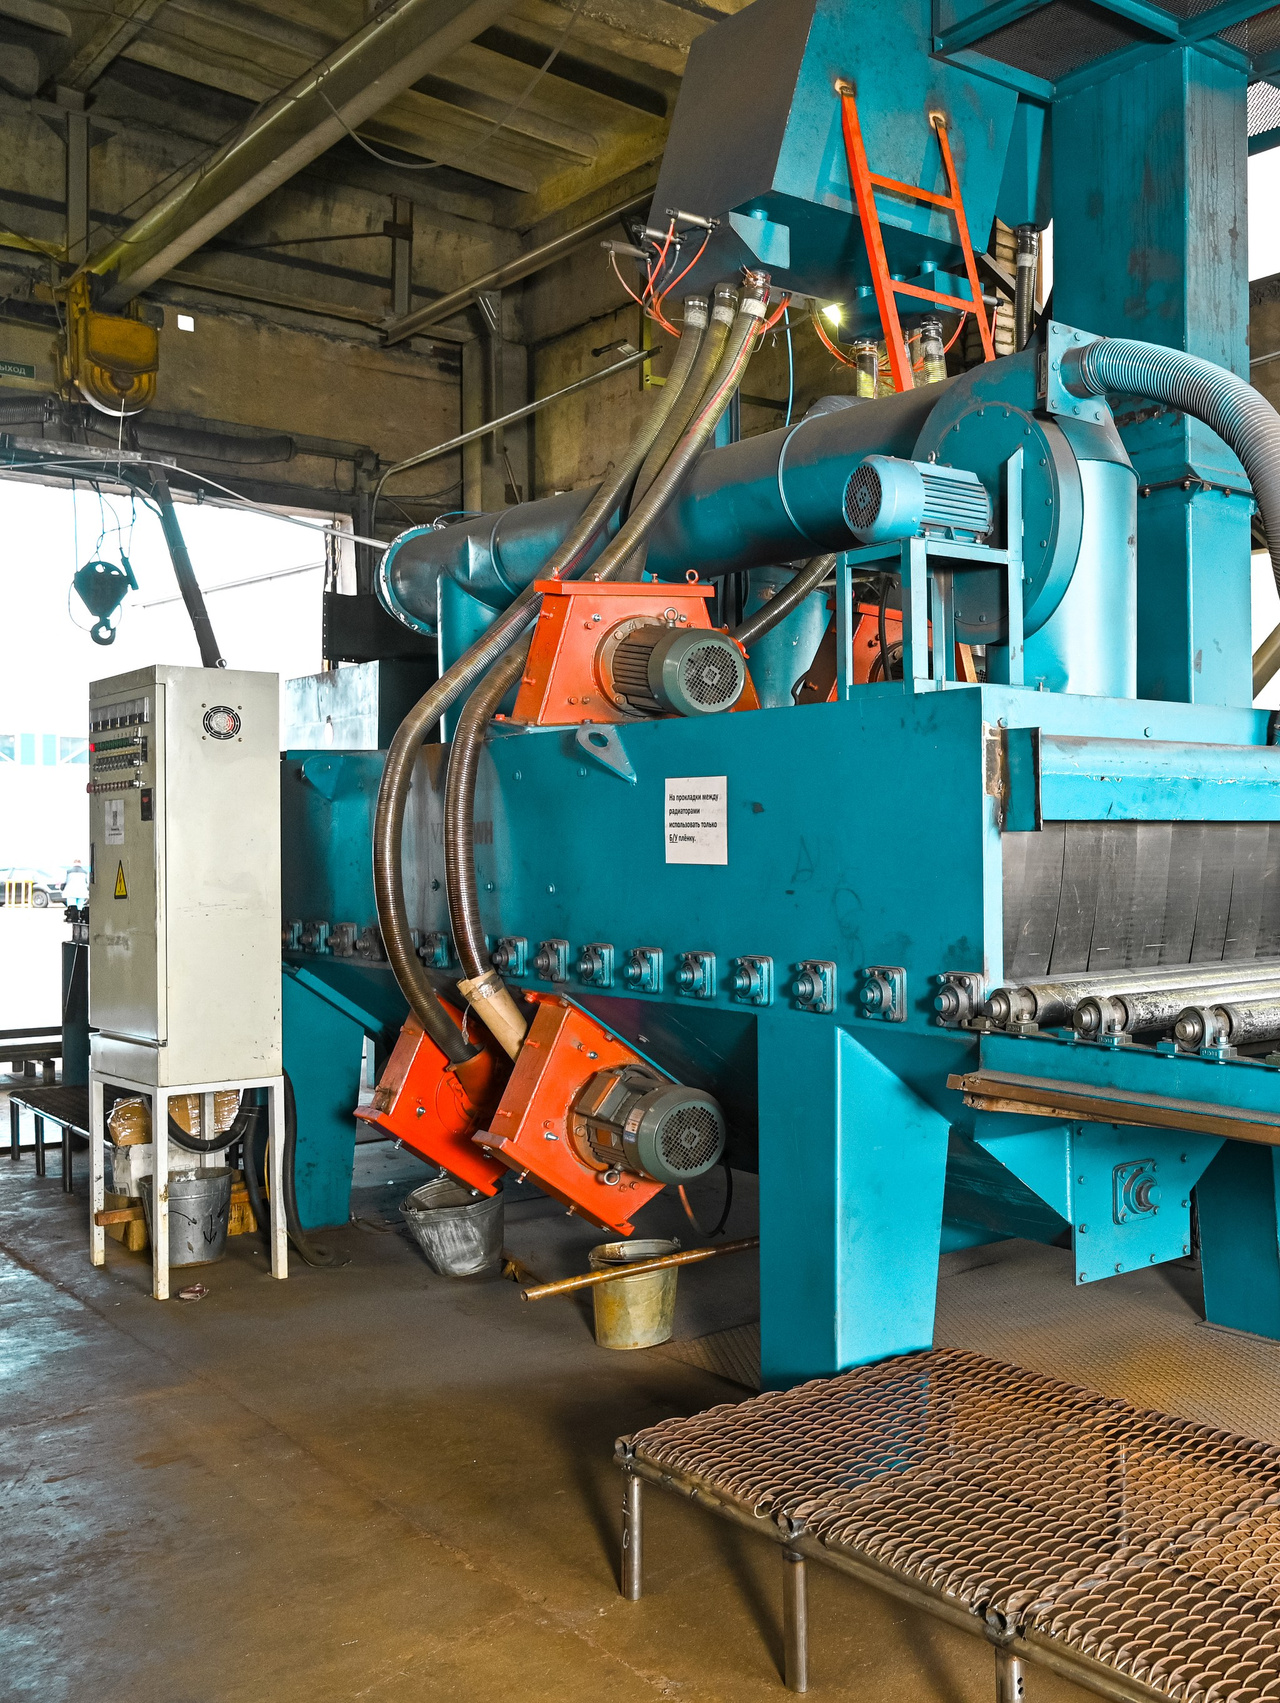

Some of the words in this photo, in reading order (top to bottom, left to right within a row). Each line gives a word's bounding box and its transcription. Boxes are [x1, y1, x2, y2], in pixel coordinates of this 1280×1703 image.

[676, 794, 701, 802] прокладки
[669, 808, 700, 816] радиаторами
[669, 833, 678, 843] Б/У
[679, 833, 696, 843] плёнку.
